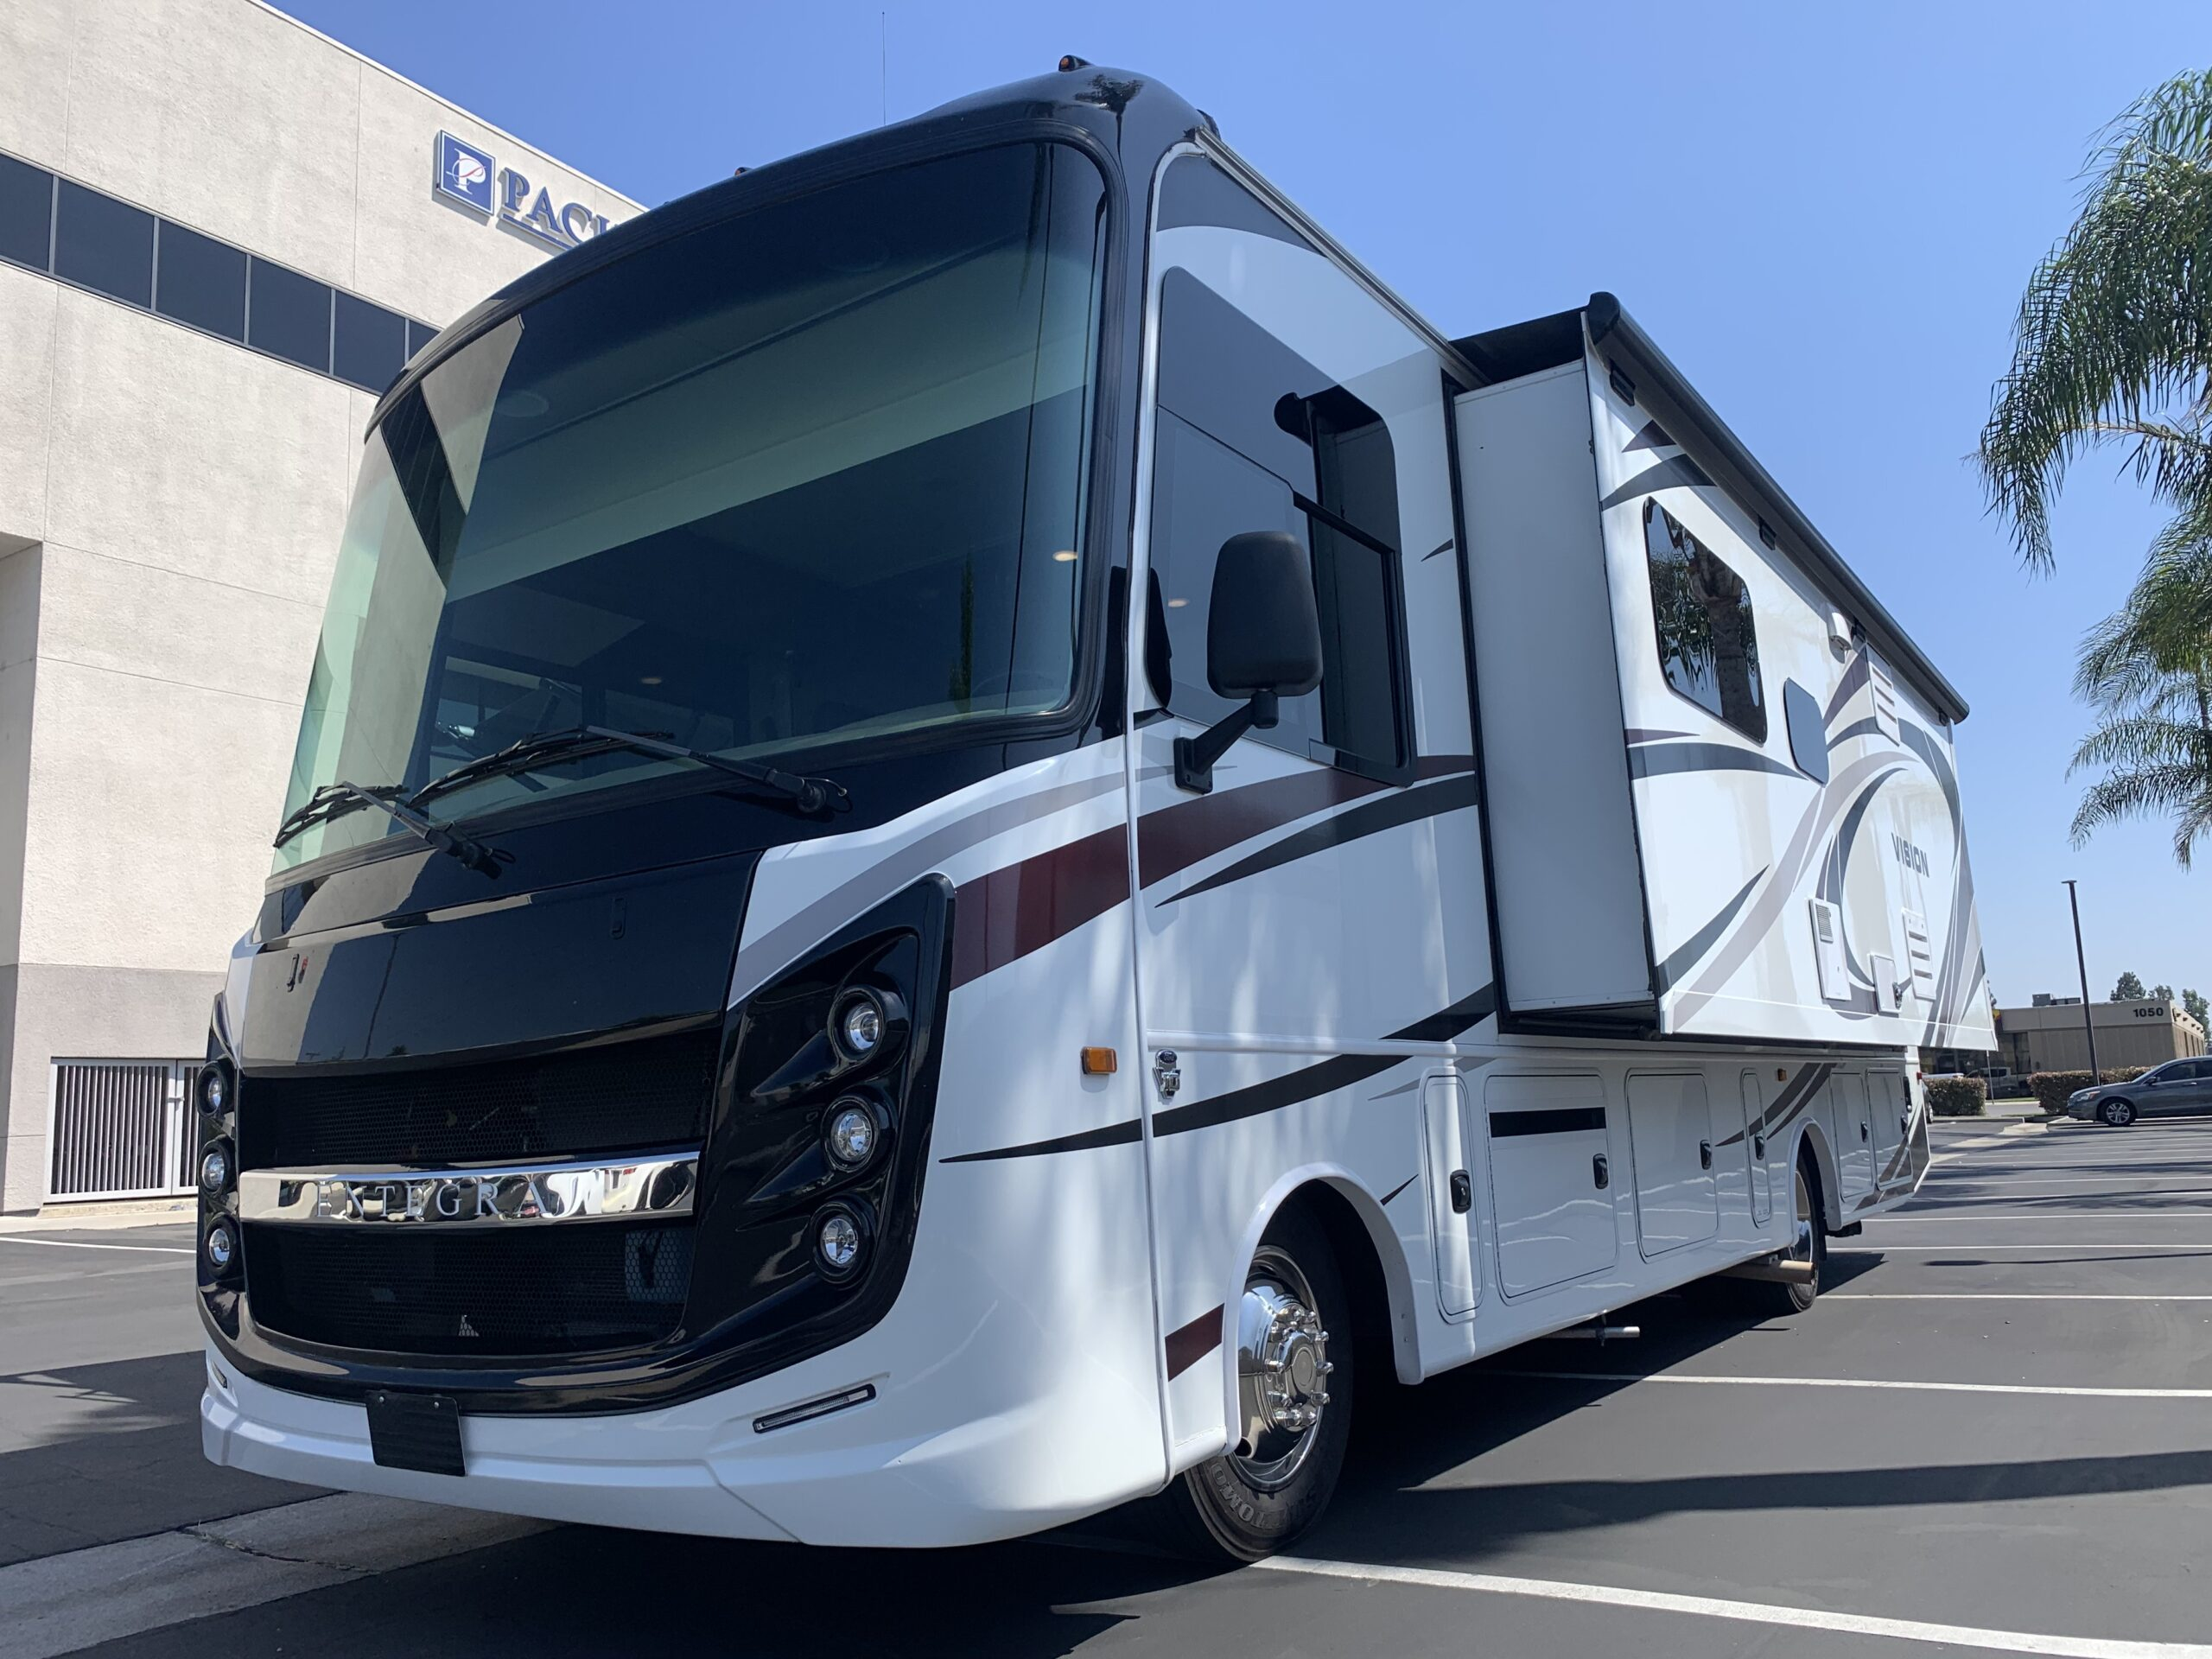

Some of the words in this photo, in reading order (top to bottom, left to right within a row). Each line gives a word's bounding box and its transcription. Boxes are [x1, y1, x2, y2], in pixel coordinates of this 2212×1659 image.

[502, 167, 610, 243] PACI
[1891, 832, 1929, 878] VISION
[2133, 1007, 2164, 1018] 1050
[315, 1181, 551, 1217] ENTEGRA
